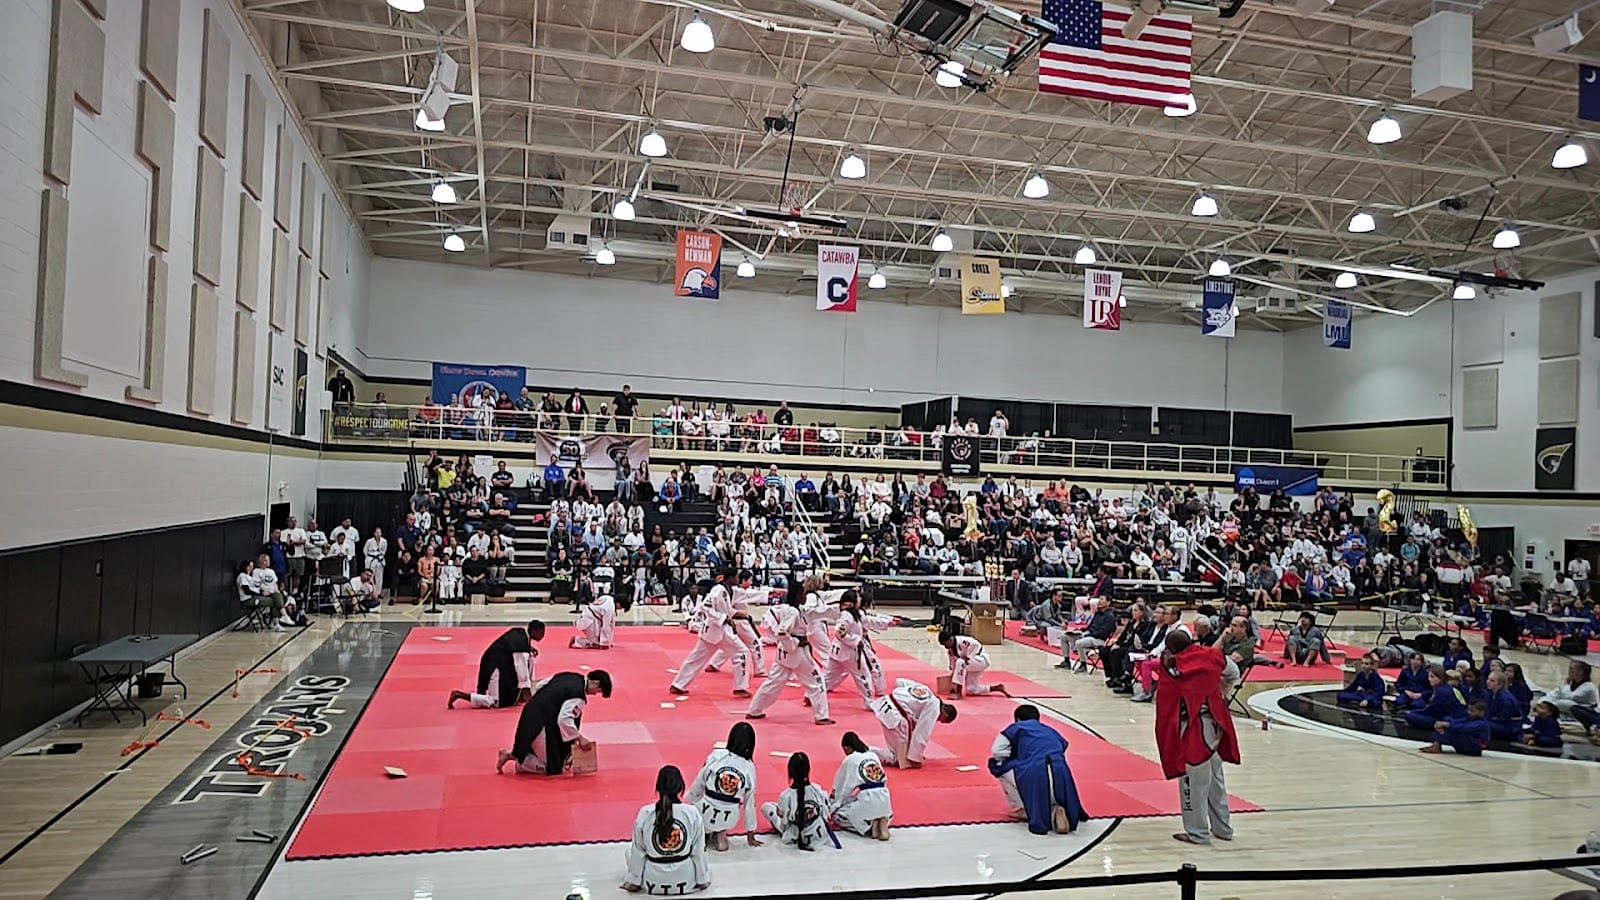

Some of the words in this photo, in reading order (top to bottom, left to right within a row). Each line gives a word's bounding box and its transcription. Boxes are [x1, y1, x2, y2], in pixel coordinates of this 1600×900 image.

[685, 234, 713, 249] CARSON-
[684, 247, 712, 264] NEWMAN
[822, 250, 855, 265] CATAWBA
[827, 276, 849, 303] C
[1205, 280, 1234, 294] LIMESTONE
[1325, 323, 1349, 340] LMU
[334, 415, 409, 429] #RESPECTOURGAME
[171, 674, 350, 805] TROJANS
[701, 802, 732, 822] YTT
[645, 880, 687, 895] YTT
